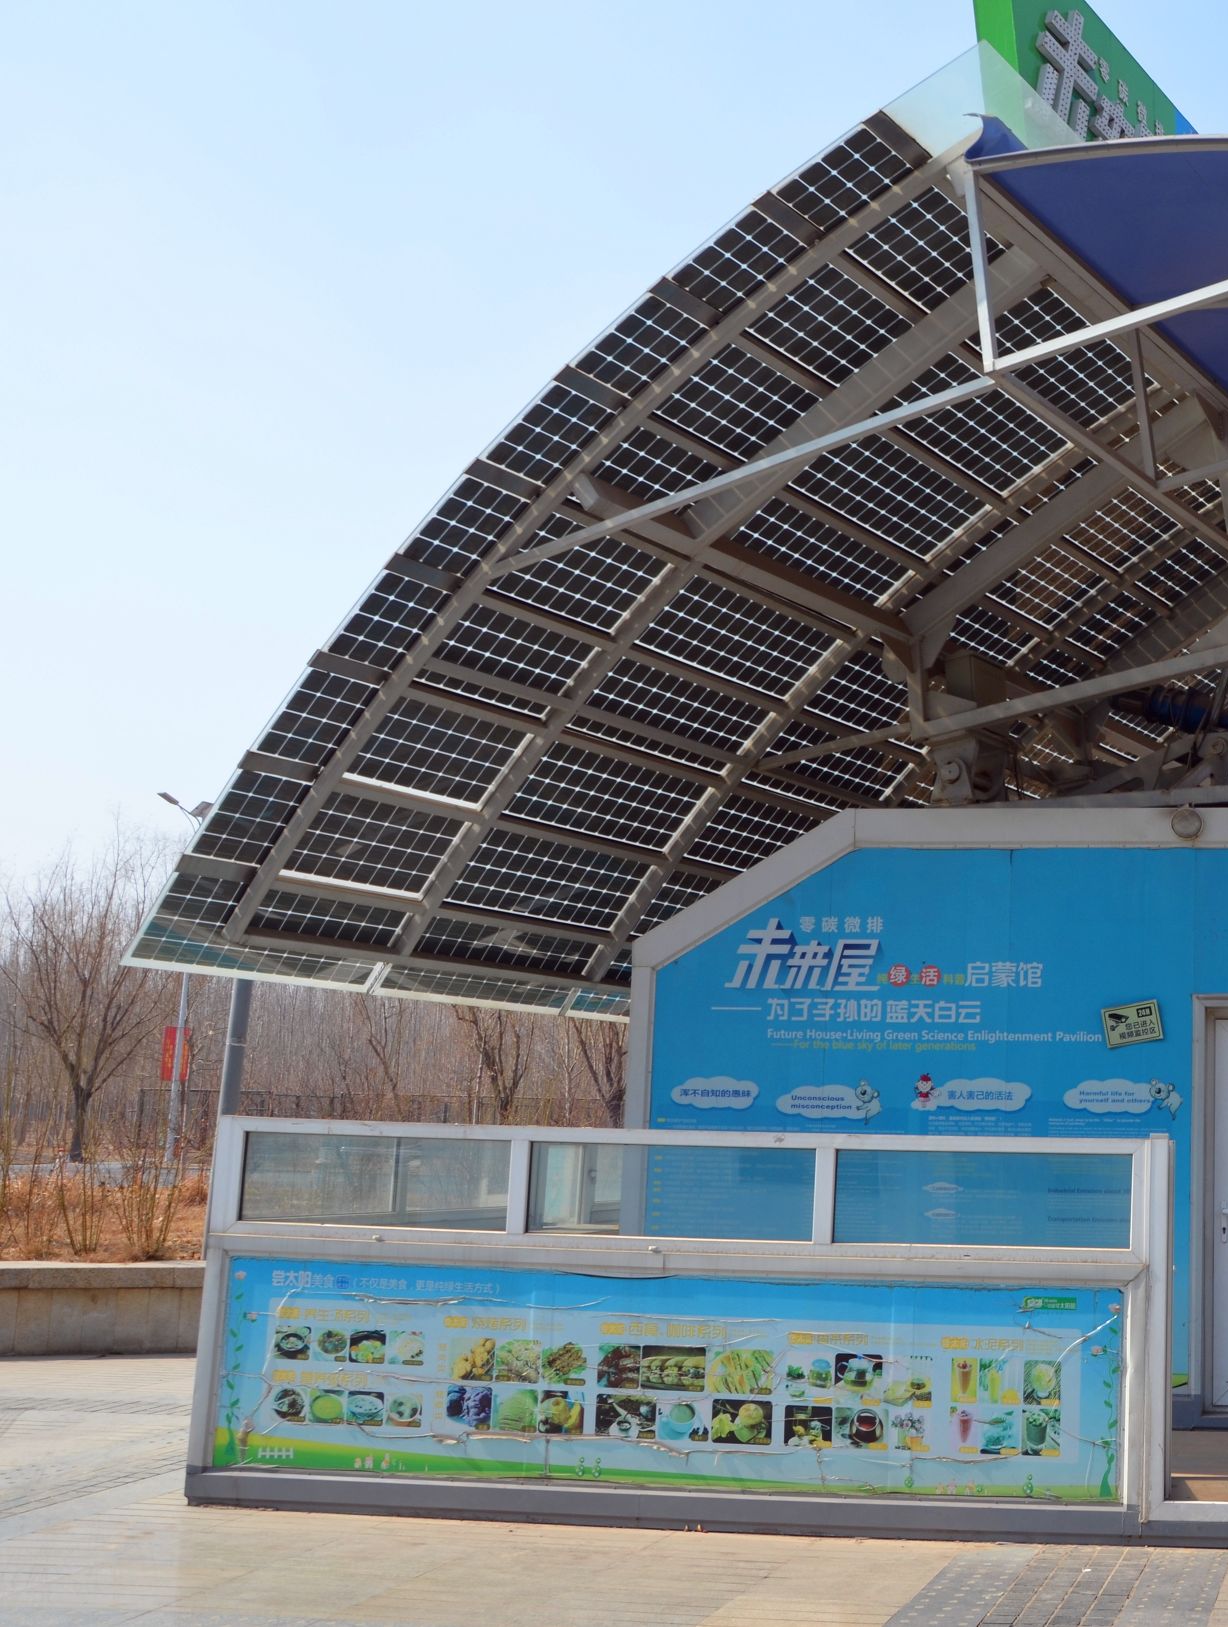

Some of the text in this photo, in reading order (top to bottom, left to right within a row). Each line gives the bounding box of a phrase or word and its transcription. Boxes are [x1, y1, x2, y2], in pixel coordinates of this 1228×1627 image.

[799, 916, 884, 933] 零碳微排
[724, 917, 881, 992] 未来屋
[1125, 1018, 1156, 1031] 您已进入
[767, 1029, 803, 1040] Future
[884, 1030, 918, 1042] Green
[921, 1030, 965, 1042] Science
[967, 1030, 1053, 1045] Enlightenment
[1055, 1031, 1102, 1043] Pavilion
[812, 1040, 829, 1050] the
[831, 1040, 854, 1050] blue
[889, 1041, 913, 1051] later
[915, 1042, 977, 1053] generations
[791, 1095, 846, 1103] Unconscious
[946, 1090, 1015, 1101] 害人害己的活法
[1078, 1097, 1152, 1105] yourself and others
[790, 1103, 853, 1112] misconception
